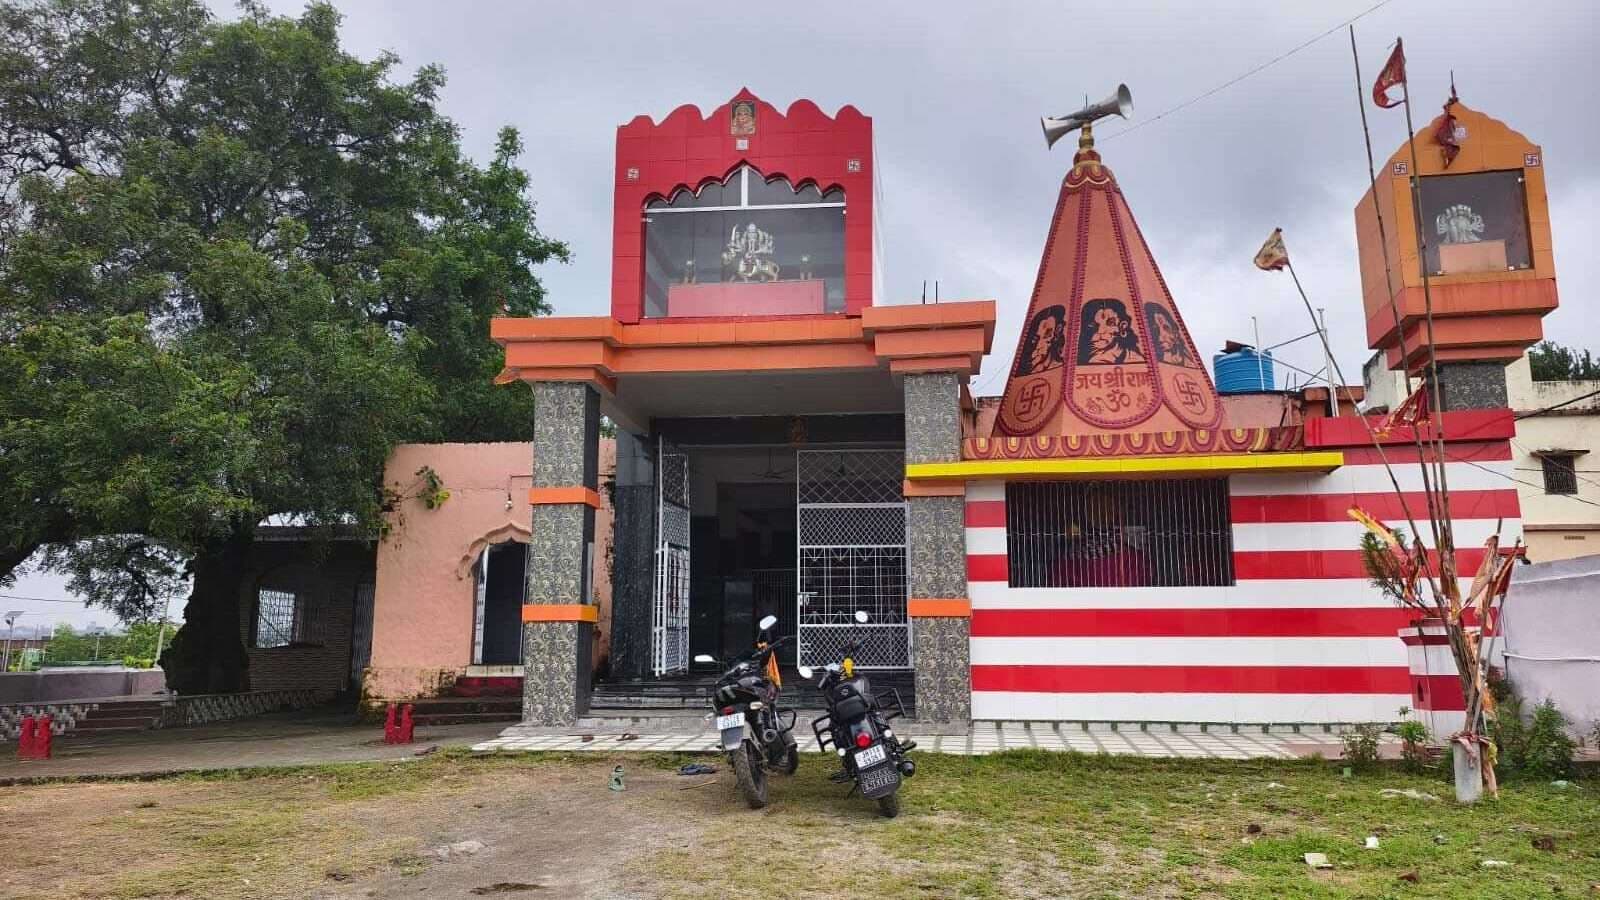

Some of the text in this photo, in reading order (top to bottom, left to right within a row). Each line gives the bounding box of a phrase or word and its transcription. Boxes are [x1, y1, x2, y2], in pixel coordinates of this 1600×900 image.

[1075, 366, 1151, 389] जय श्री राम
